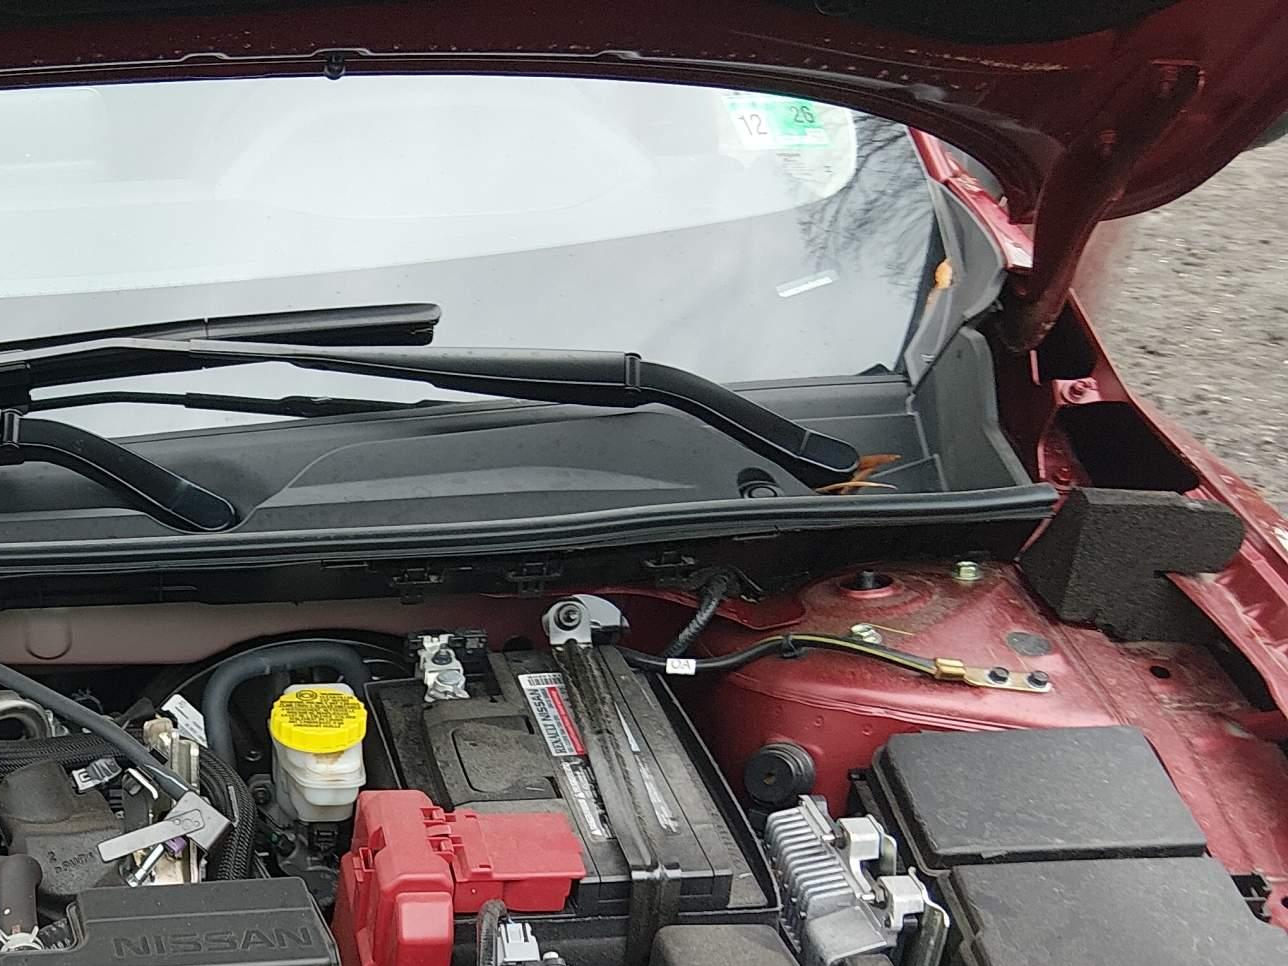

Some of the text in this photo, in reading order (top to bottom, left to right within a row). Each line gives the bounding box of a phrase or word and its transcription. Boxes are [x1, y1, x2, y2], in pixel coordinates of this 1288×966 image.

[737, 113, 768, 136] 12
[790, 105, 816, 123] 26
[528, 687, 552, 722] NISSAN
[112, 927, 312, 958] NISSAN
